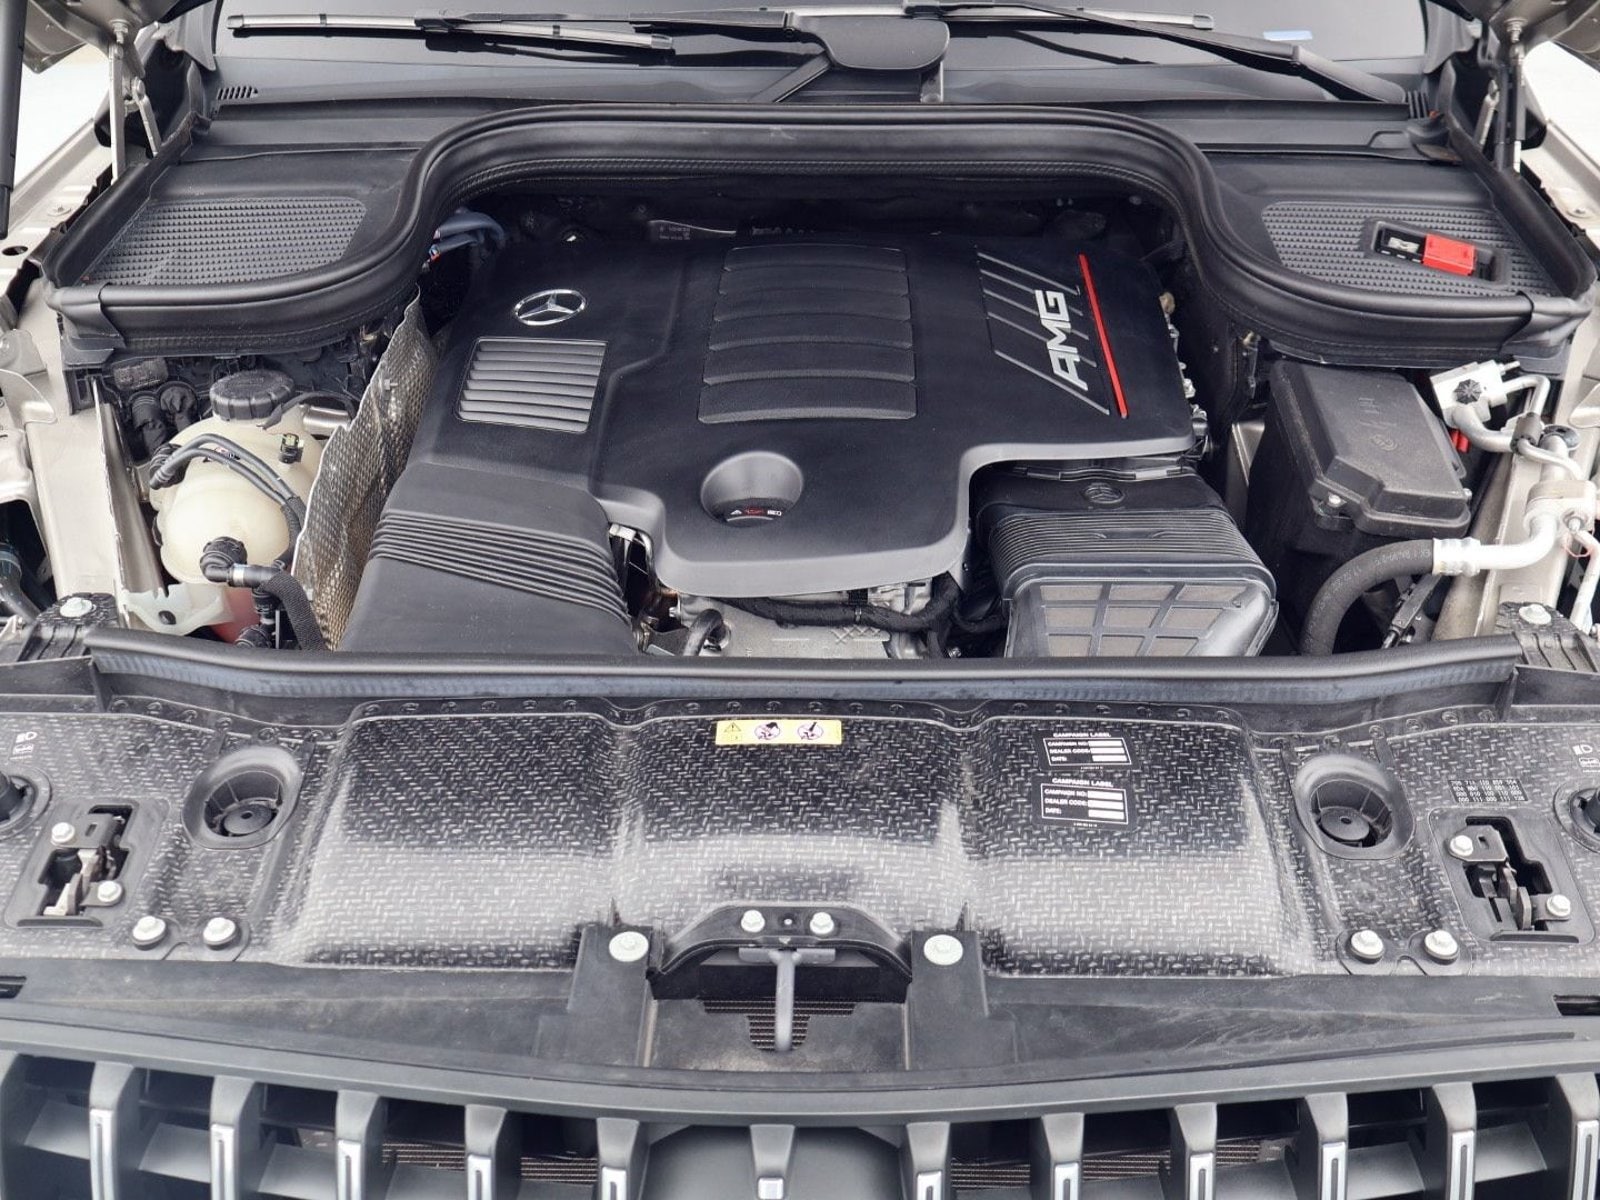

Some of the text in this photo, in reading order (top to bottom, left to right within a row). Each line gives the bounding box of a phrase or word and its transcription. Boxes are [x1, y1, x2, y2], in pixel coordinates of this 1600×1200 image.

[1034, 289, 1088, 391] AMG
[1052, 777, 1113, 788] CAMPAIGN LABEL
